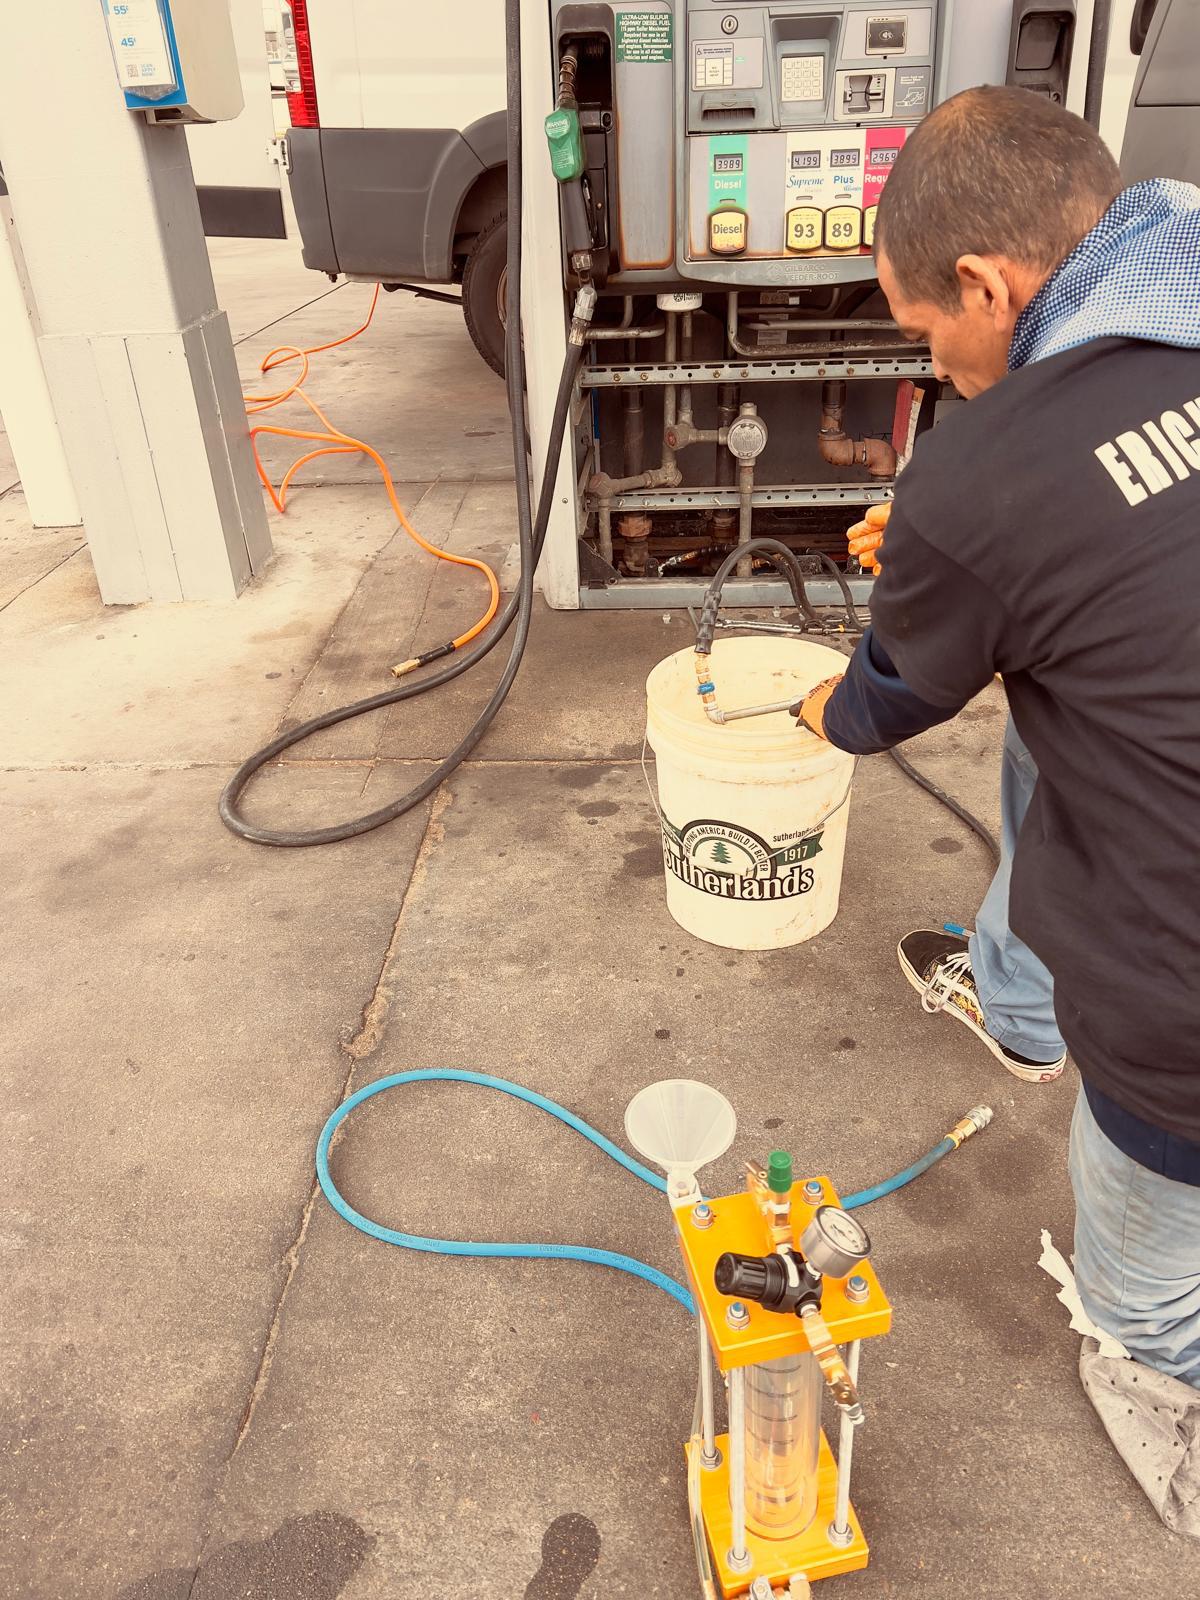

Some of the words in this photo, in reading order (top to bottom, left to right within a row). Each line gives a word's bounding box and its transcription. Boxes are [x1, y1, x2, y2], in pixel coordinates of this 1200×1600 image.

[714, 179, 742, 190] Diesel
[786, 174, 825, 189] Supreme
[833, 175, 854, 184] Plus
[864, 173, 889, 185] Regu
[713, 223, 743, 234] Diesel
[794, 223, 815, 238] 93
[831, 222, 853, 238] 89
[697, 826, 726, 836] AMERICA
[728, 830, 750, 846] BUILD
[748, 842, 759, 851] IT
[783, 845, 809, 862] 1917
[662, 831, 815, 900] Sutherlands
